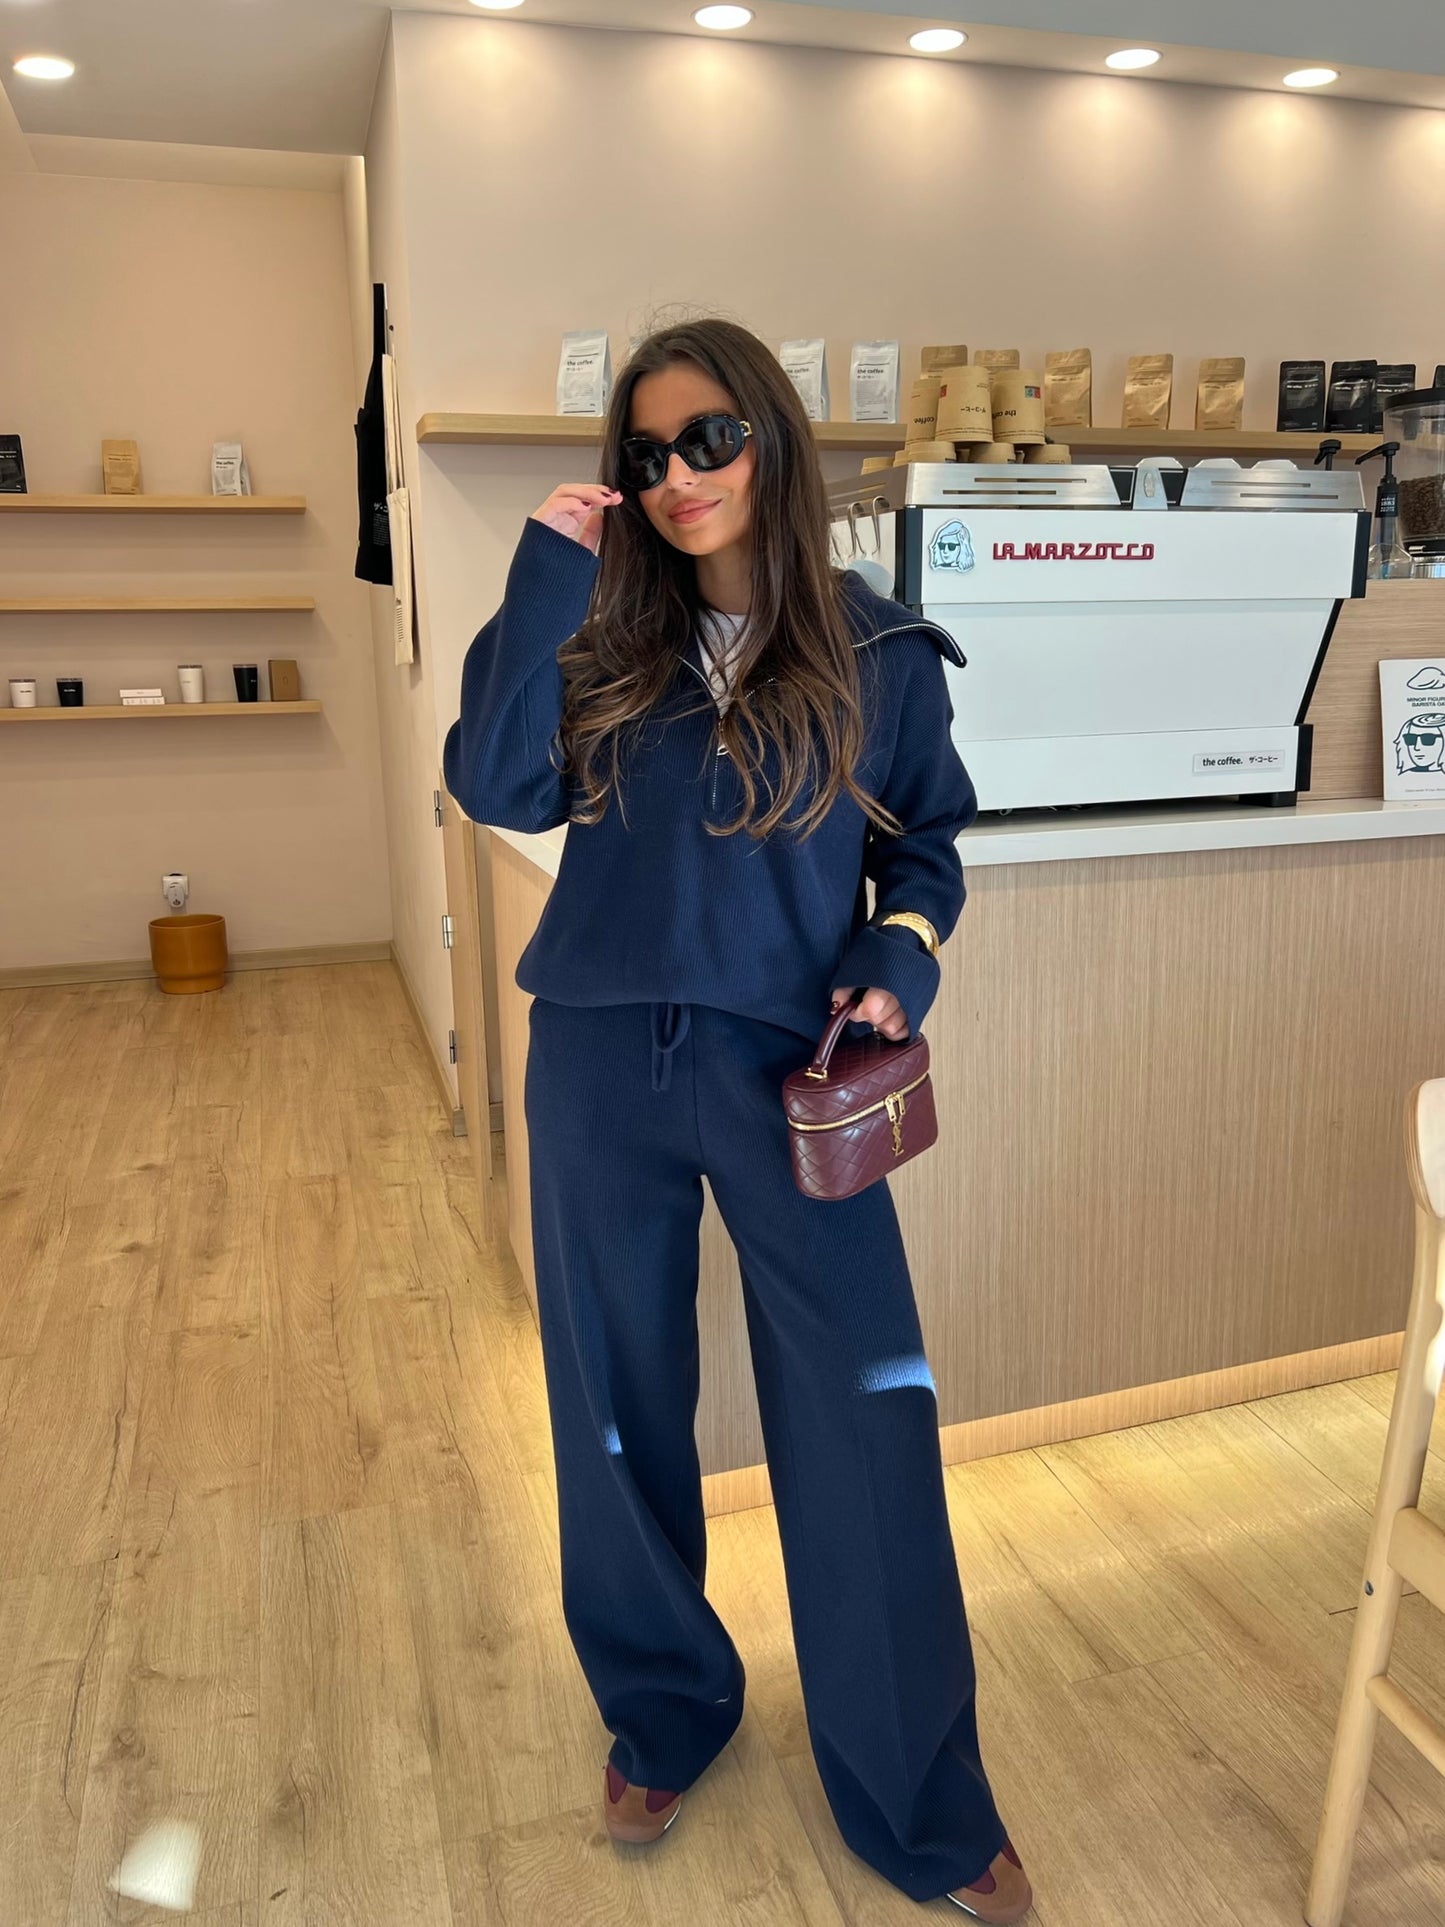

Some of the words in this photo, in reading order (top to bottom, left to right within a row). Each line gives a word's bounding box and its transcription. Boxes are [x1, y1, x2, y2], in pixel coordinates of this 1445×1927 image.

[1004, 409, 1017, 417] the
[993, 543, 1015, 560] LA
[1025, 543, 1155, 560] MARZOCCO
[1202, 758, 1216, 766] the
[1217, 756, 1243, 766] coffee.
